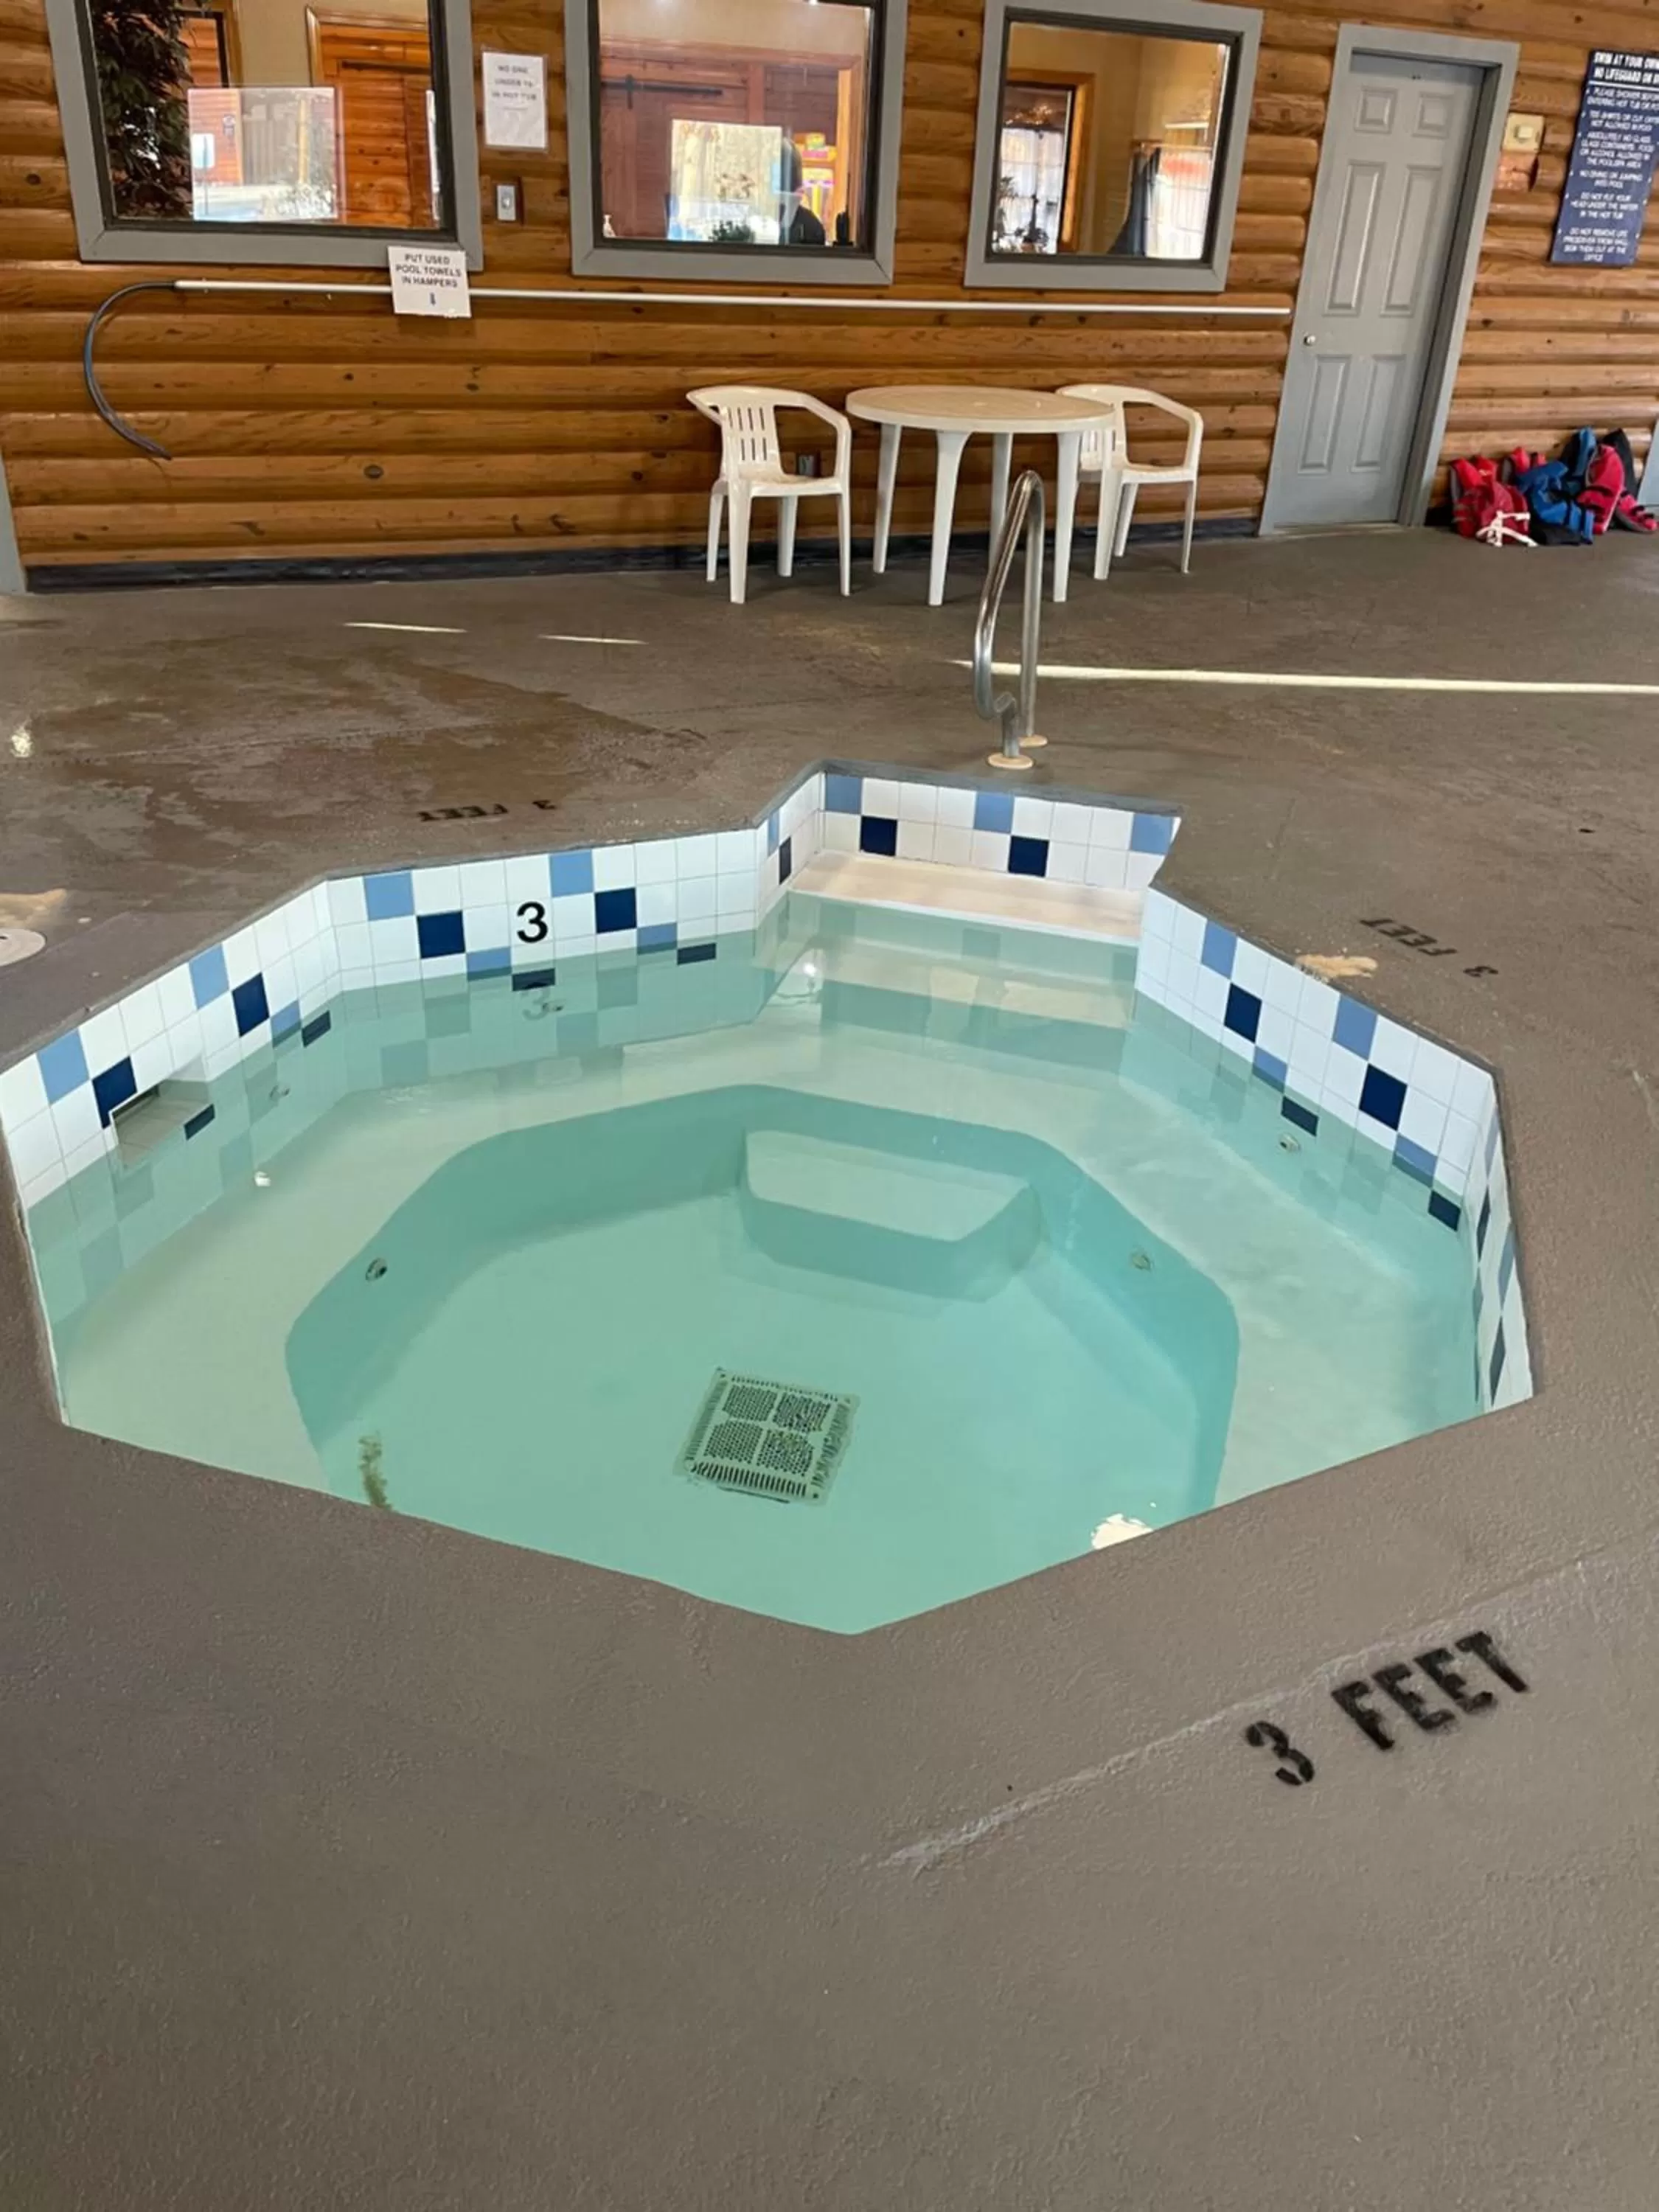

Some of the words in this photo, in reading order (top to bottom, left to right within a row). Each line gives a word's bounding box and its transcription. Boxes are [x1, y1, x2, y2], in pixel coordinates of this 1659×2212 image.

[1613, 55, 1623, 66] AT
[1595, 68, 1604, 78] NO
[1606, 69, 1641, 83] LIFEGUARD
[405, 254, 422, 262] PUT
[425, 255, 451, 265] USED
[395, 264, 421, 274] POOL
[424, 266, 462, 277] TOWELS
[401, 275, 411, 285] IN
[412, 276, 458, 288] HAMPERS
[517, 901, 549, 944] 3
[1359, 918, 1458, 956] FEET
[1244, 1720, 1315, 1787] 3
[1330, 1630, 1530, 1751] FEET
